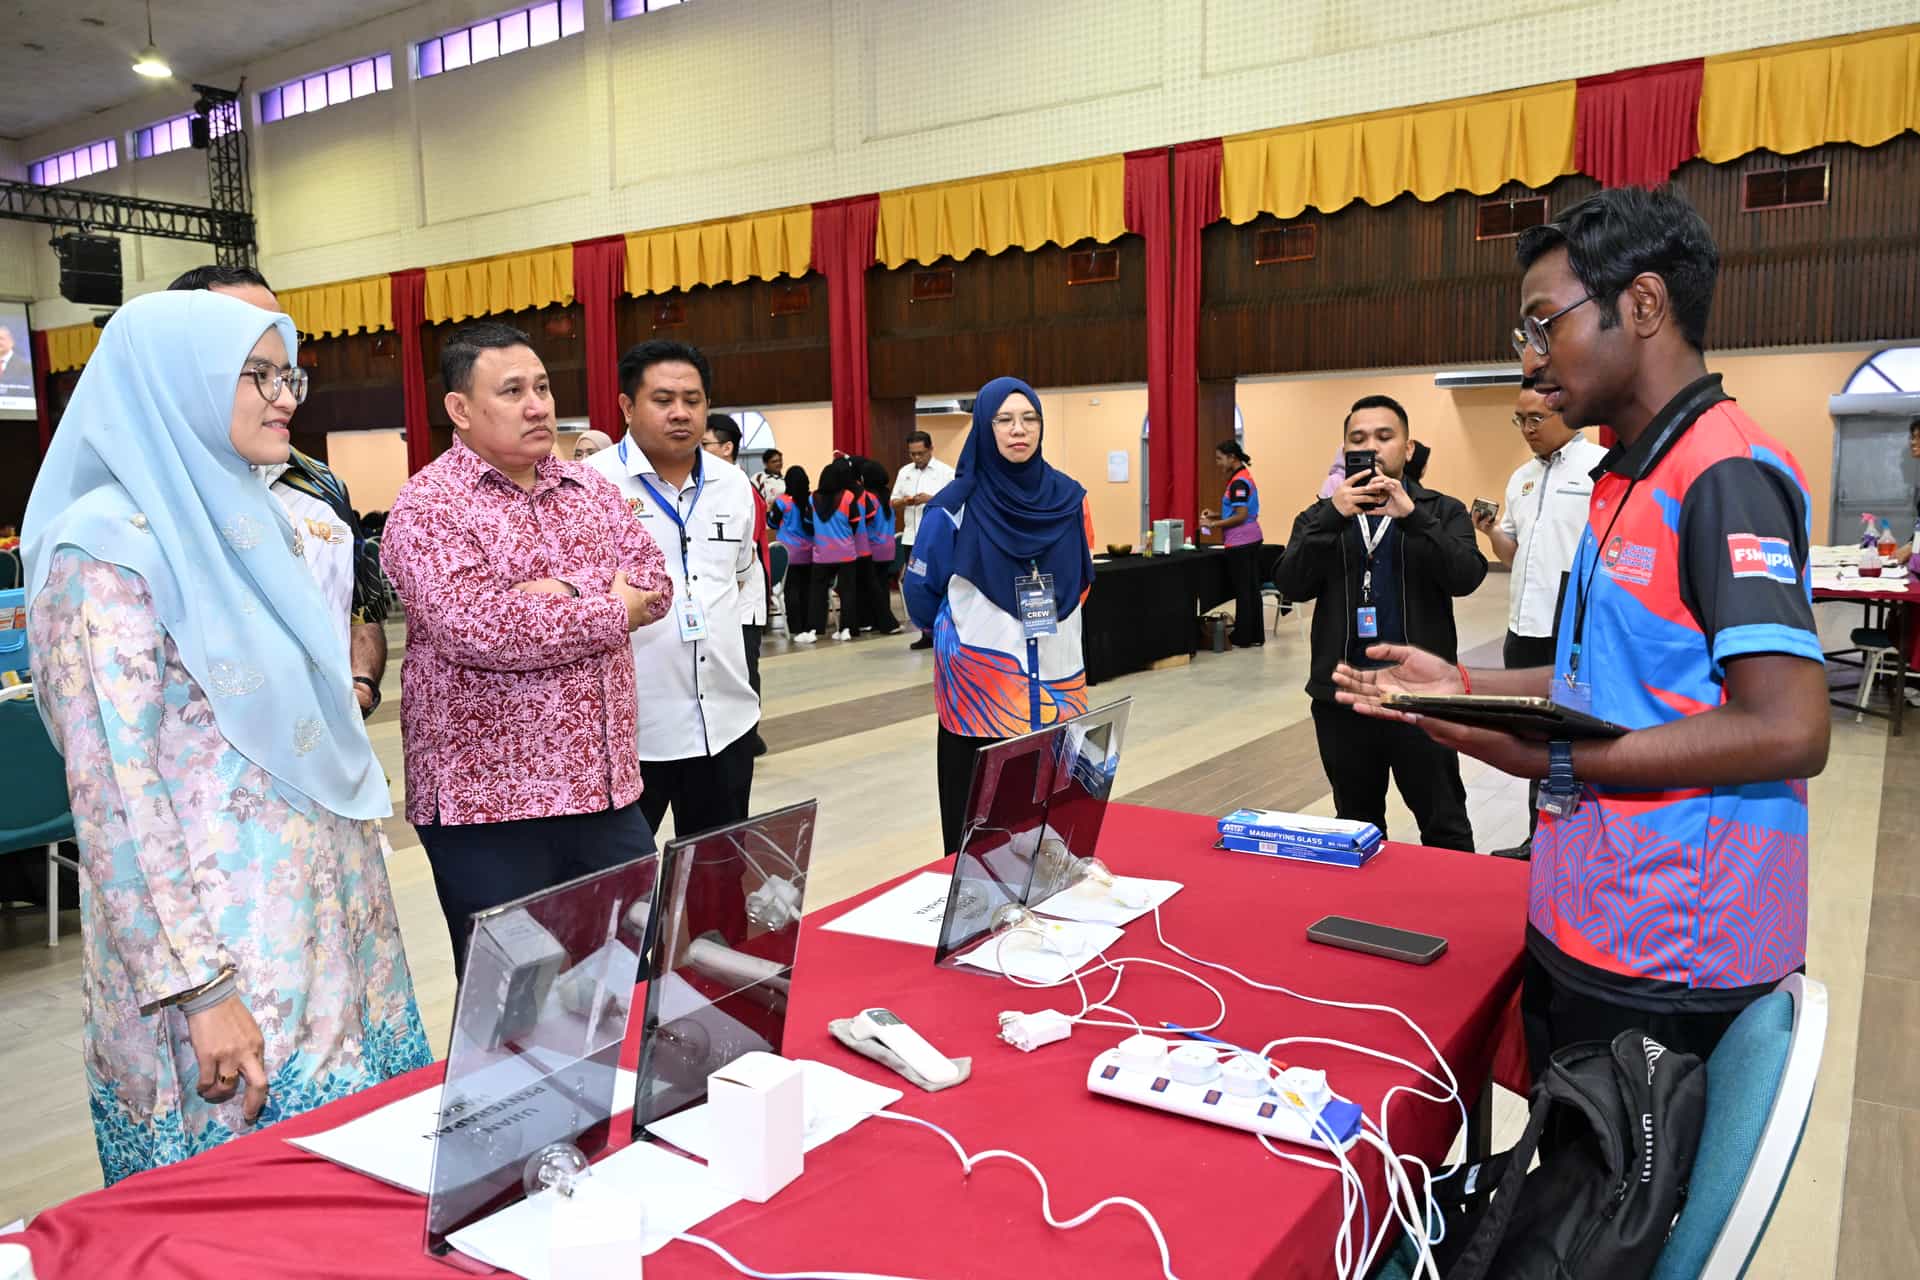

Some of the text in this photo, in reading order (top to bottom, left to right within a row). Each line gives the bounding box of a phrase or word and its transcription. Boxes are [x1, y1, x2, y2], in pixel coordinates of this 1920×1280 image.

[1027, 611, 1050, 619] CREW
[1249, 829, 1296, 842] MAGNIFYING
[1297, 835, 1323, 846] GLASS
